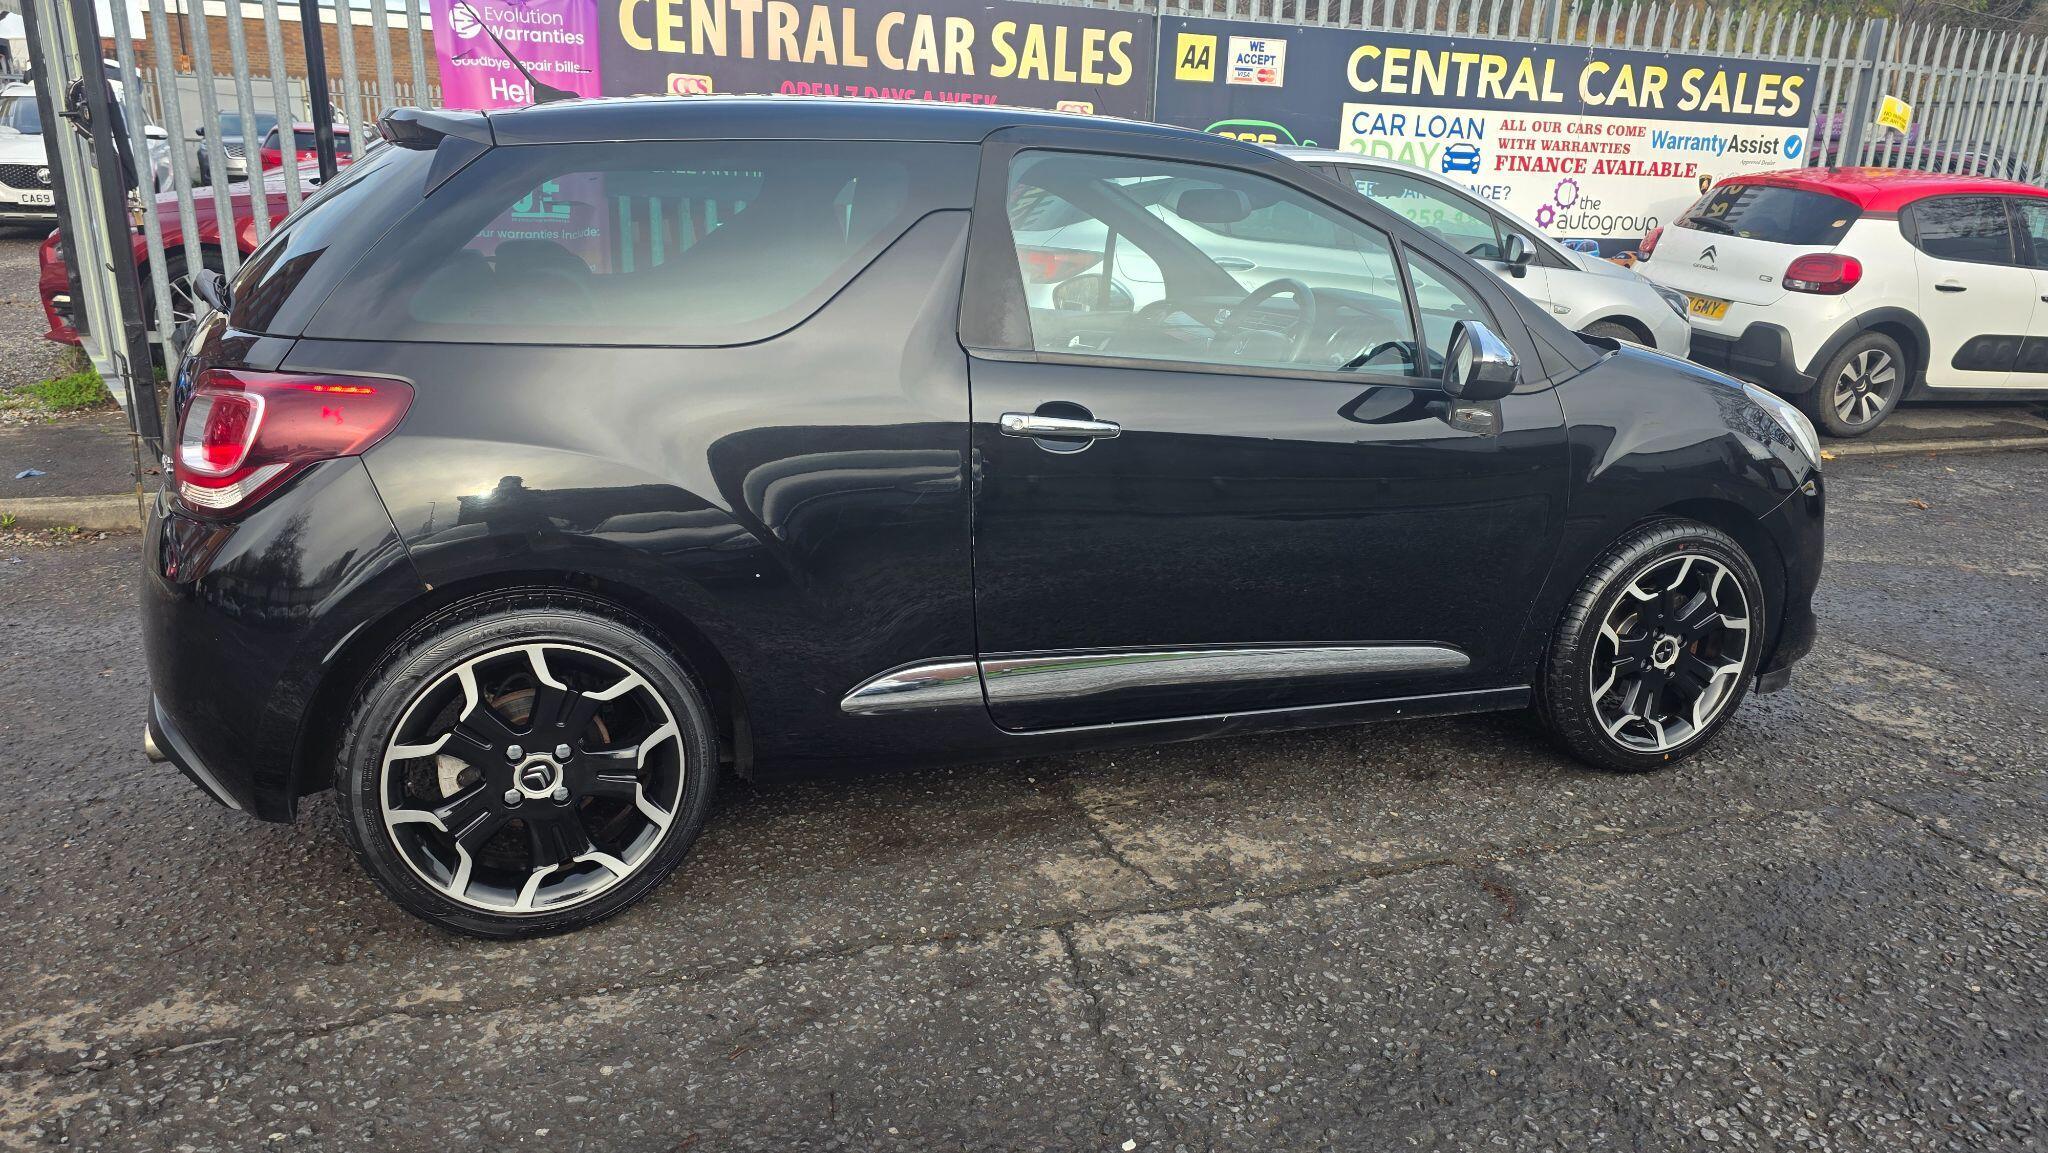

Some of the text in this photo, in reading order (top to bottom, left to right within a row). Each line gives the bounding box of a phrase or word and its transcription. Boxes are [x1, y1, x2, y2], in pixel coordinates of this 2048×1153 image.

[484, 6, 563, 25] Evolution
[485, 25, 585, 45] Warranties
[618, 0, 1133, 86] CENTRAL CAR SALES
[1250, 41, 1265, 52] WE
[1181, 44, 1210, 70] AA
[1236, 53, 1276, 66] ACCEPT
[1346, 45, 1805, 118] CENTRAL CAR SALES
[1352, 111, 1485, 140] CAR LOAN
[1499, 119, 1647, 138] ALL OUR CARS COME
[1498, 137, 1631, 155] WITH WARRANTIES
[1494, 154, 1698, 179] FINANCE AVAILABLE
[21, 194, 50, 203] CA69
[1579, 195, 1602, 210] the
[497, 229, 559, 239] warranties
[1556, 212, 1659, 237] autogroup
[1692, 299, 1721, 316] GMY
